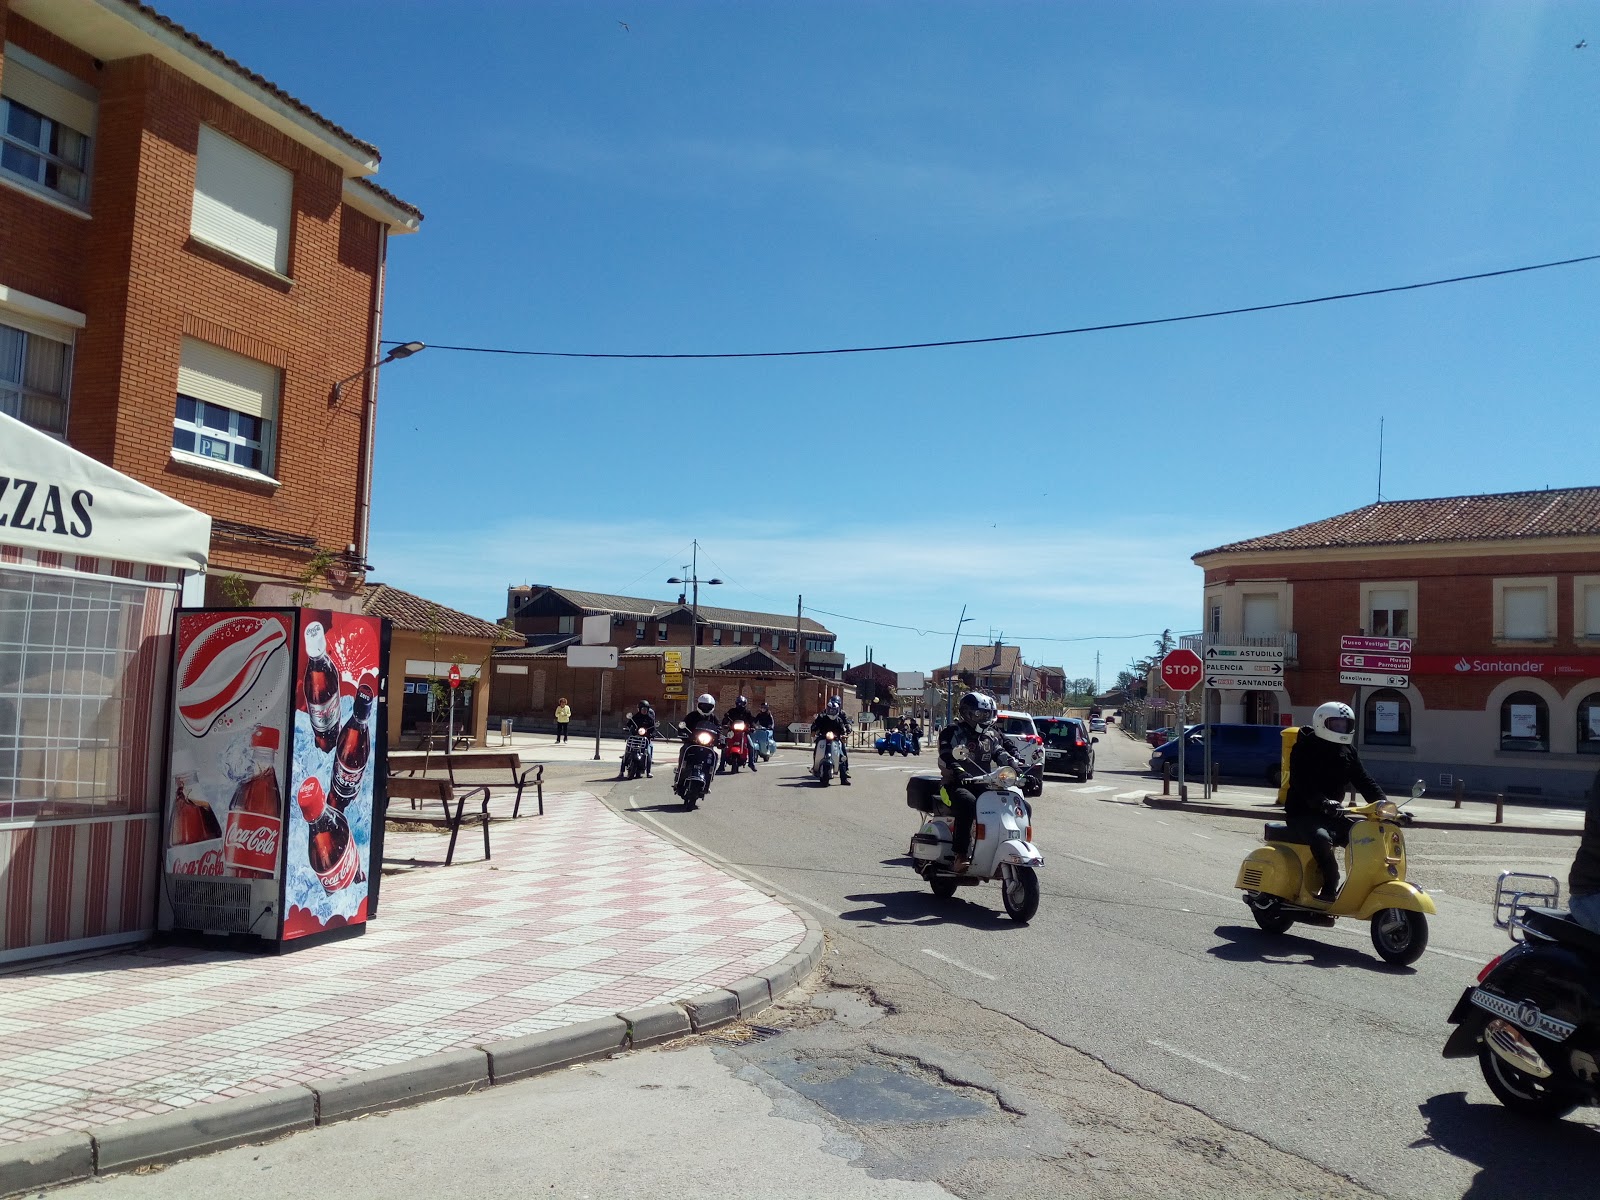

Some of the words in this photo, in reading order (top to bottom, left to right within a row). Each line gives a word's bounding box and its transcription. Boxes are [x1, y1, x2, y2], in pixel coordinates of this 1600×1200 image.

[201, 440, 210, 454] P
[1165, 665, 1199, 675] STOP
[1473, 661, 1544, 672] Santander
[225, 822, 278, 855] Coca-Cola
[1519, 1005, 1537, 1026] 16
